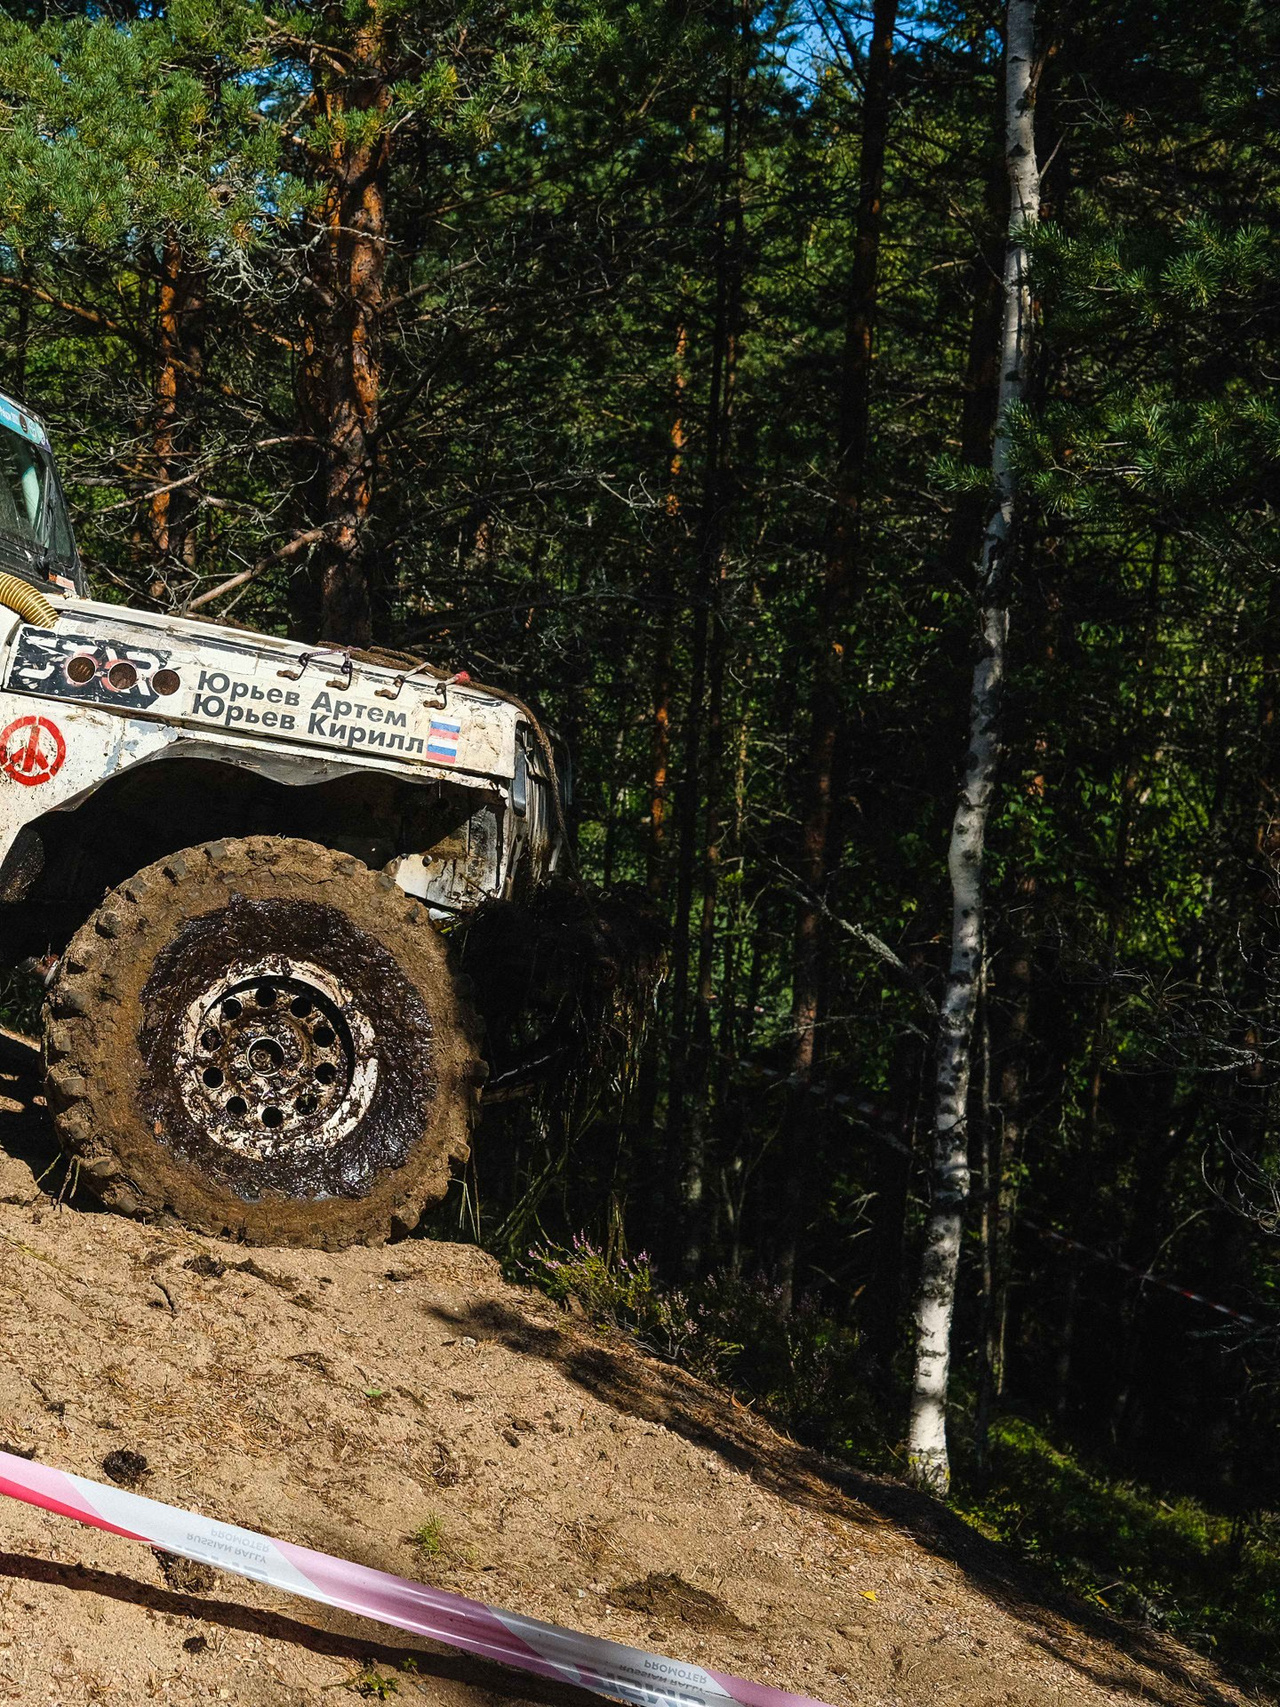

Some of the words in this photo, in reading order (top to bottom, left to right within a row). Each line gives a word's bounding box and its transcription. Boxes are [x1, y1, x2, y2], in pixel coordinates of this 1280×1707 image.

[192, 693, 296, 730] Юрьев
[307, 712, 425, 754] Кирилл
[197, 670, 300, 706] Юрьев
[310, 691, 407, 728] Артем
